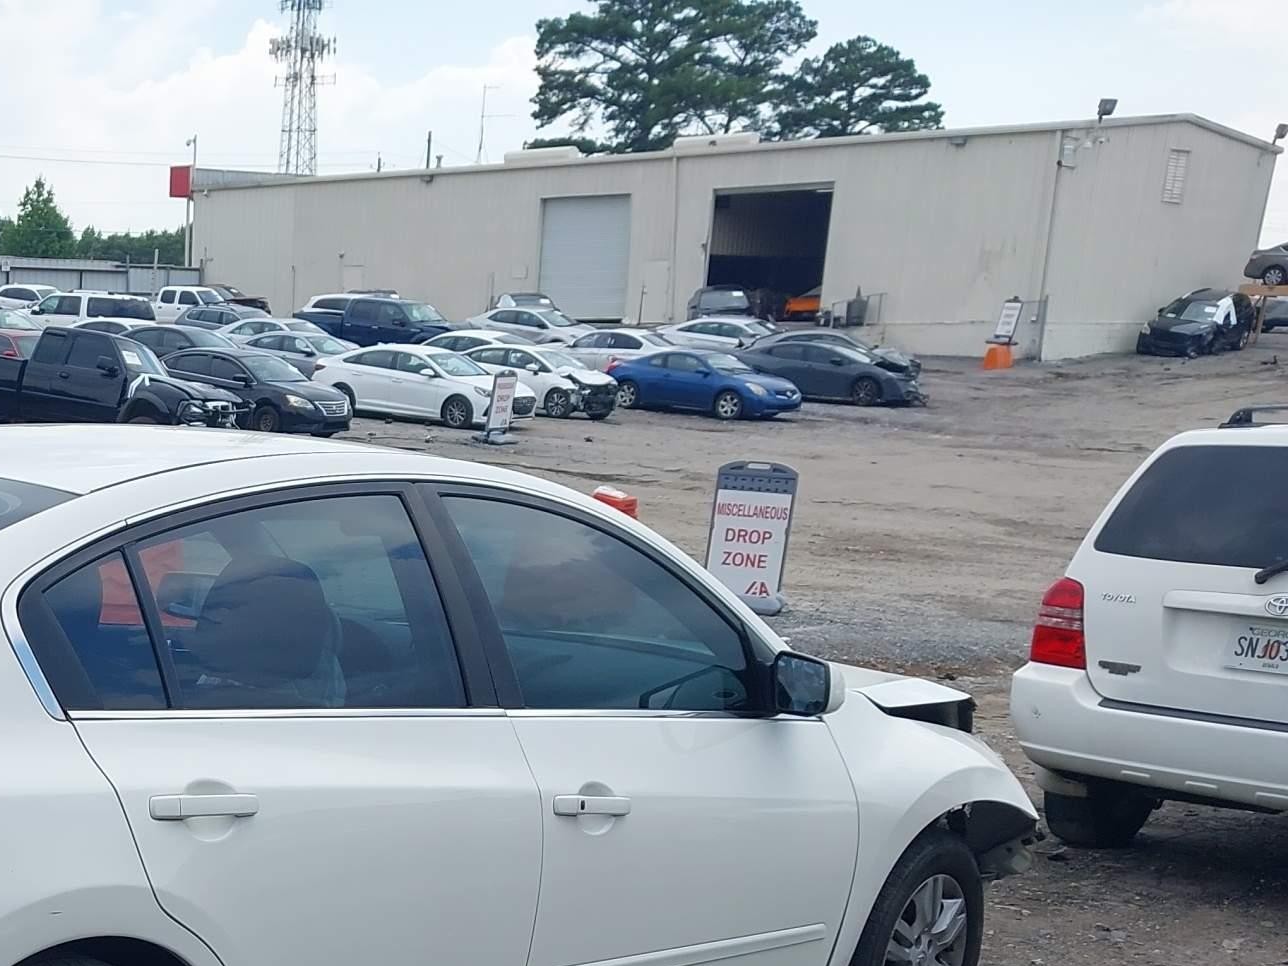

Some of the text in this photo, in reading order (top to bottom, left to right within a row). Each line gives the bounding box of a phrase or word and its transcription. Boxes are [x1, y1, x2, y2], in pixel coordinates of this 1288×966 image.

[717, 502, 789, 521] MISCELLANEOUS
[724, 528, 773, 545] DROP
[721, 551, 768, 569] ZONE
[1100, 592, 1137, 604] TOYOTA
